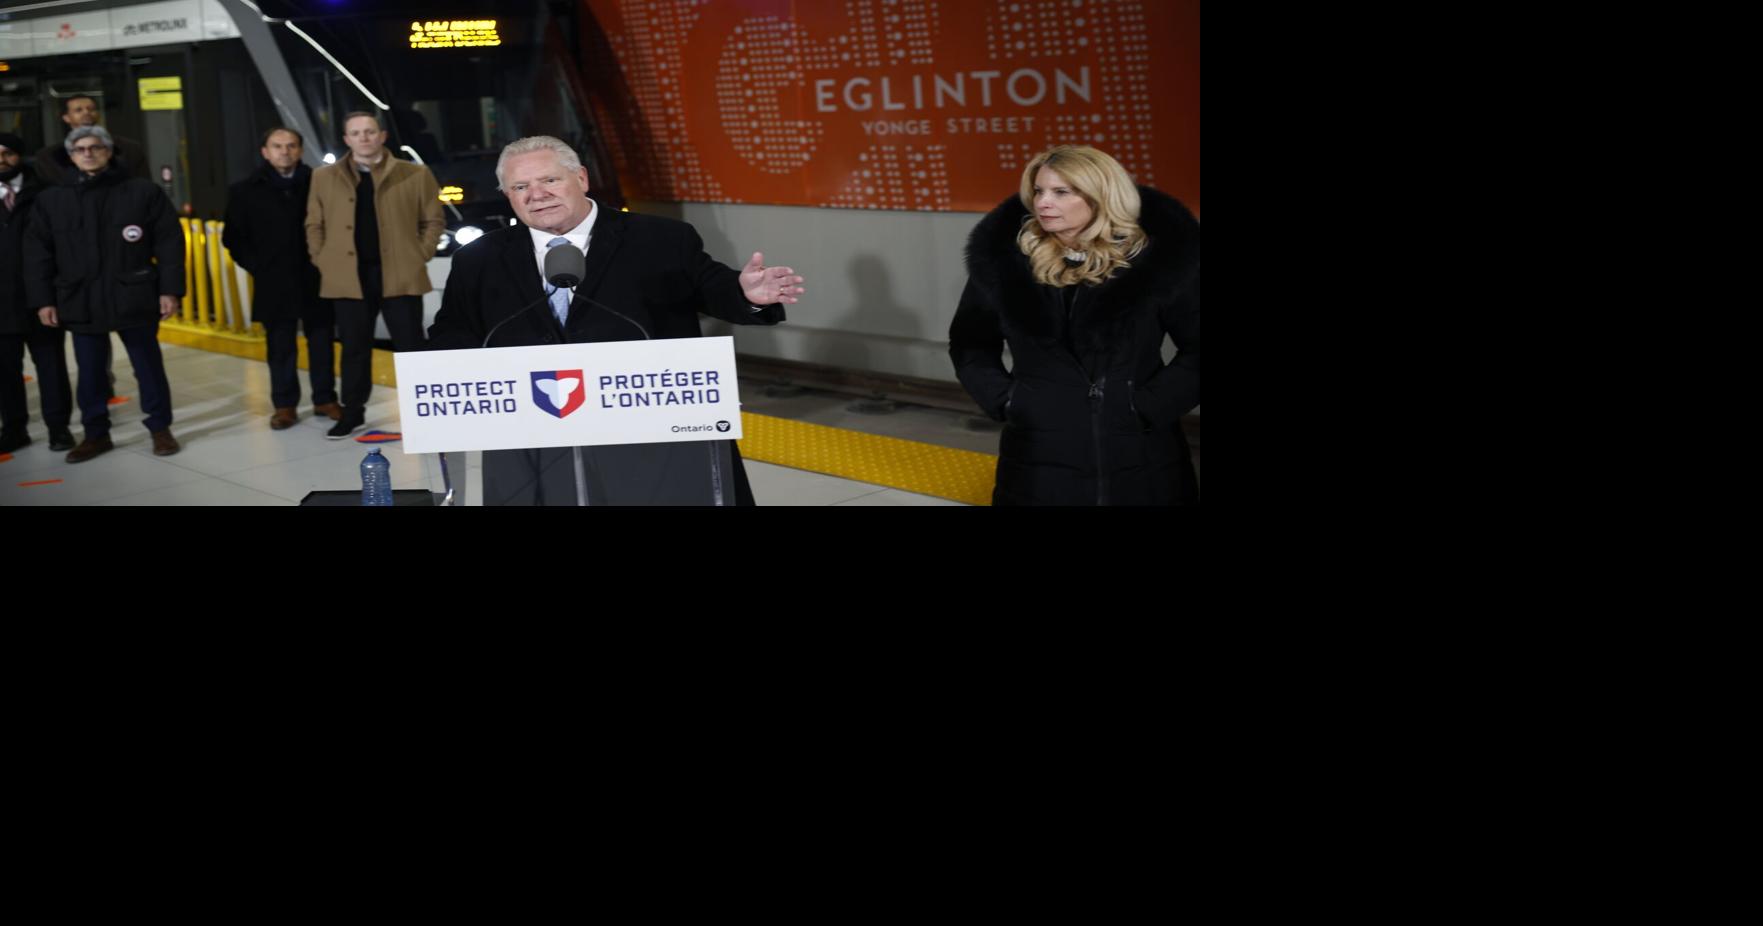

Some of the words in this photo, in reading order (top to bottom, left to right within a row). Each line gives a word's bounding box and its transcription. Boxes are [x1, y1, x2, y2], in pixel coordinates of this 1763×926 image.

[815, 66, 1091, 112] EGLINTON
[862, 119, 932, 136] YONGE
[947, 117, 1035, 134] STREET
[600, 369, 720, 390] PROTÉGER
[415, 380, 517, 399] PROTECT
[601, 389, 720, 408] L'ONTARIO
[416, 399, 517, 417] ONTARIO
[671, 424, 714, 433] Ontario
